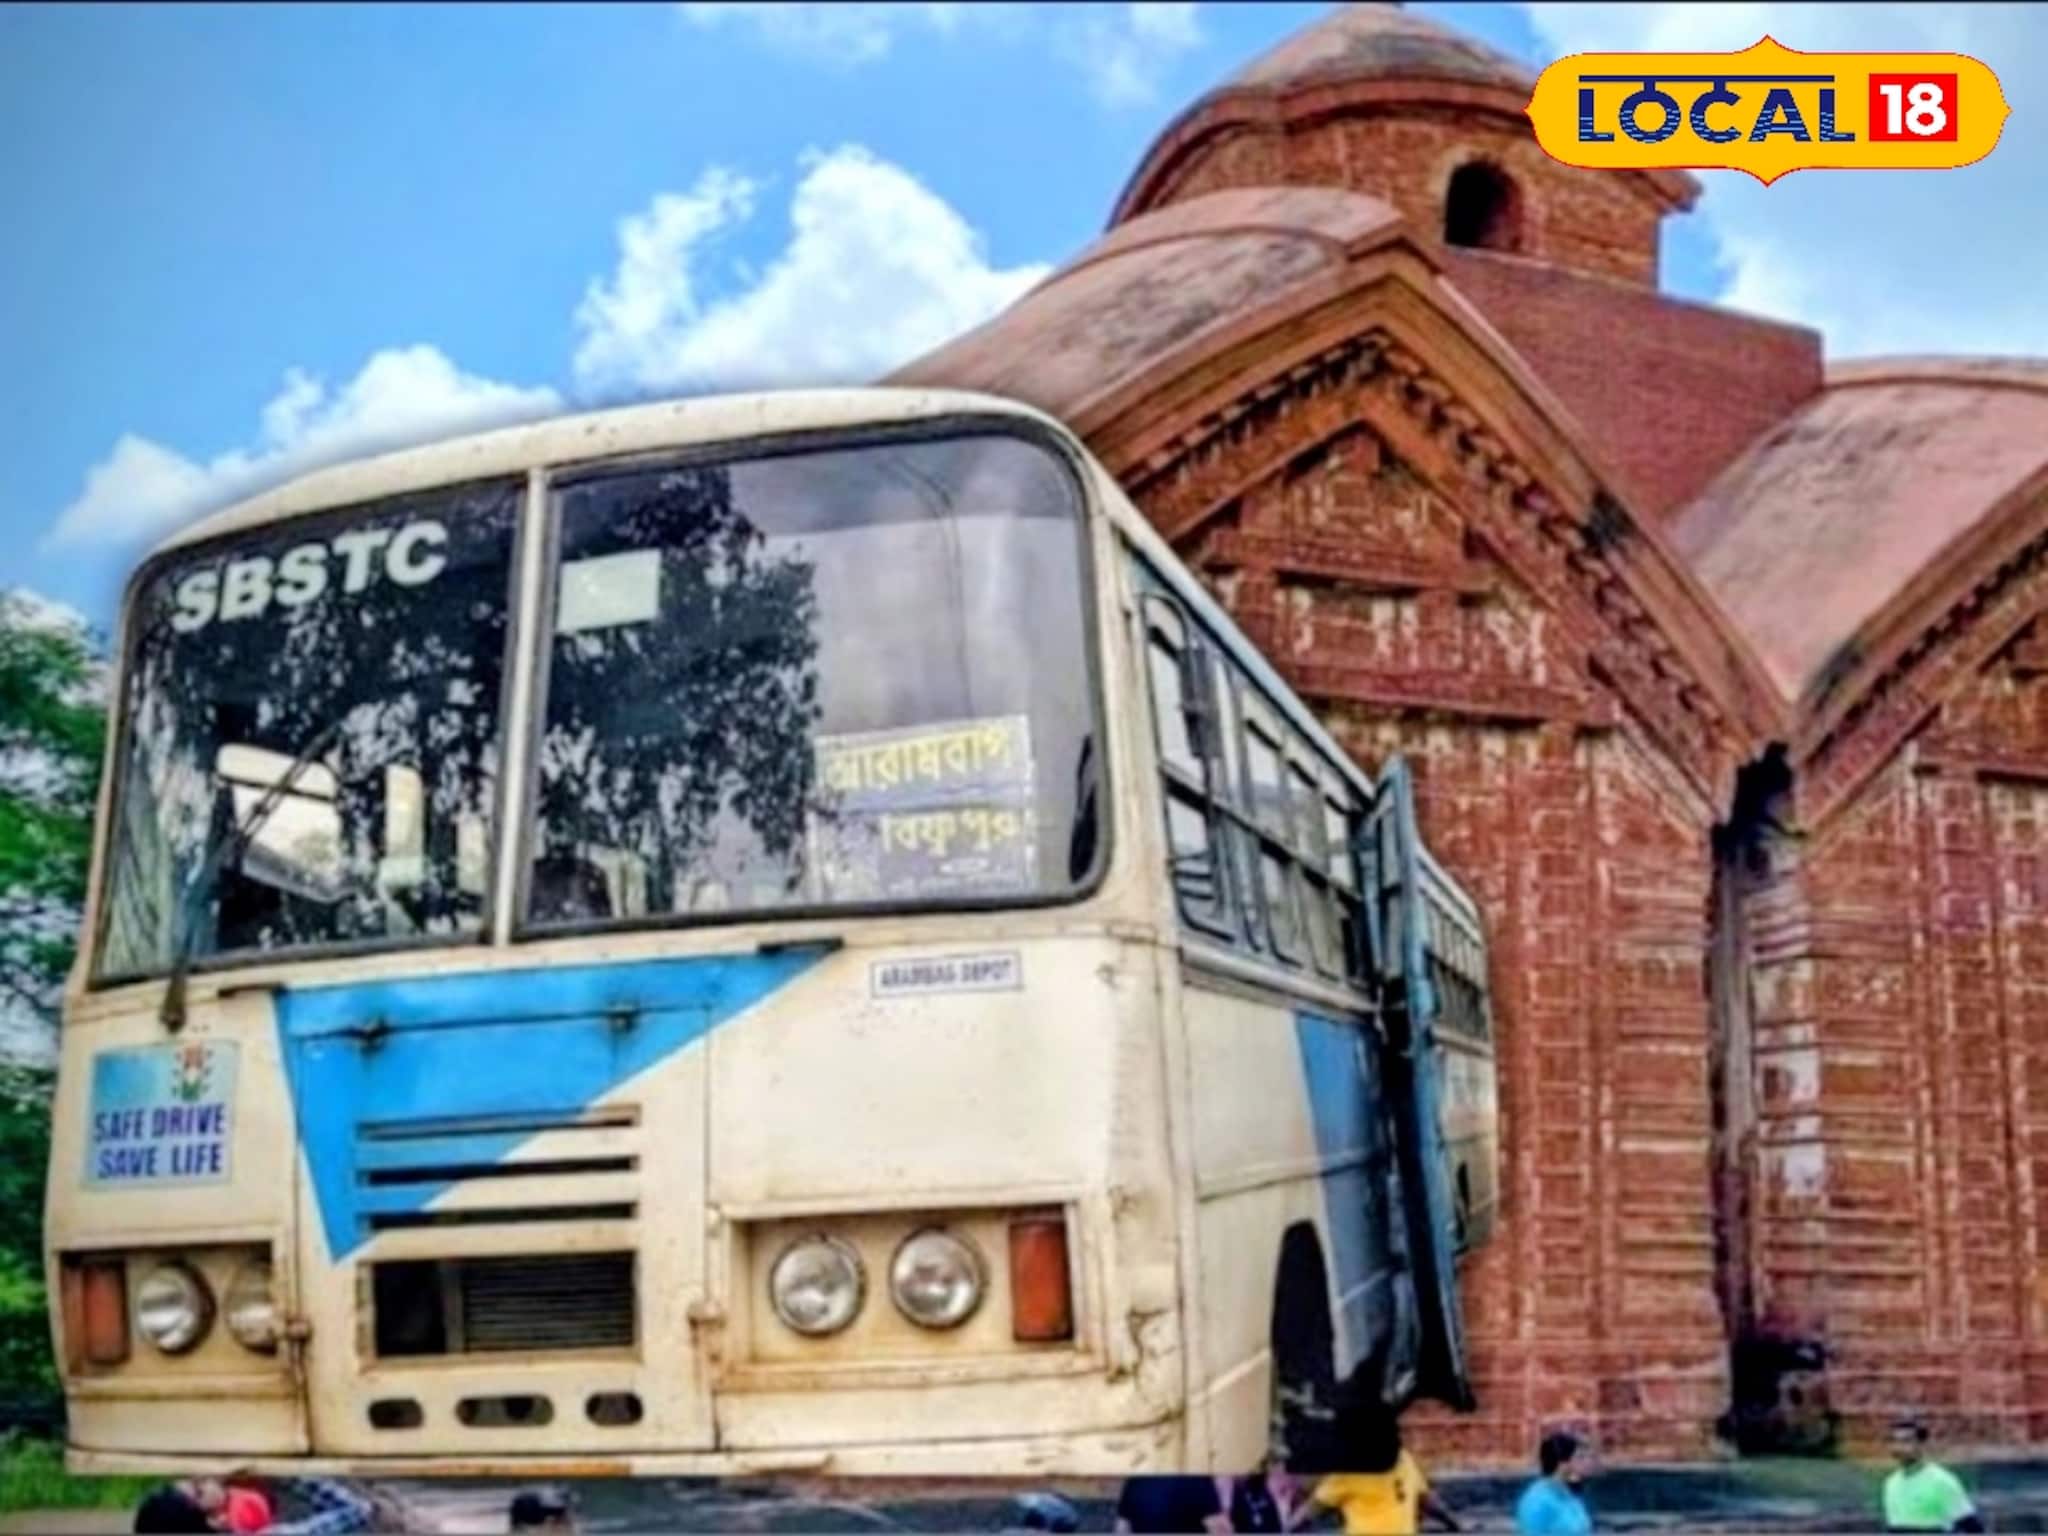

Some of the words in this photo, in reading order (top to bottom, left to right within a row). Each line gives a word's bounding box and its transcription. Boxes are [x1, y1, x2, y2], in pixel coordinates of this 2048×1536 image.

[171, 519, 449, 633] SBSTC
[94, 1108, 145, 1144] SAFE
[152, 1103, 225, 1138] DRIVE
[98, 1145, 158, 1180] SAVE
[171, 1143, 222, 1176] LIFE
